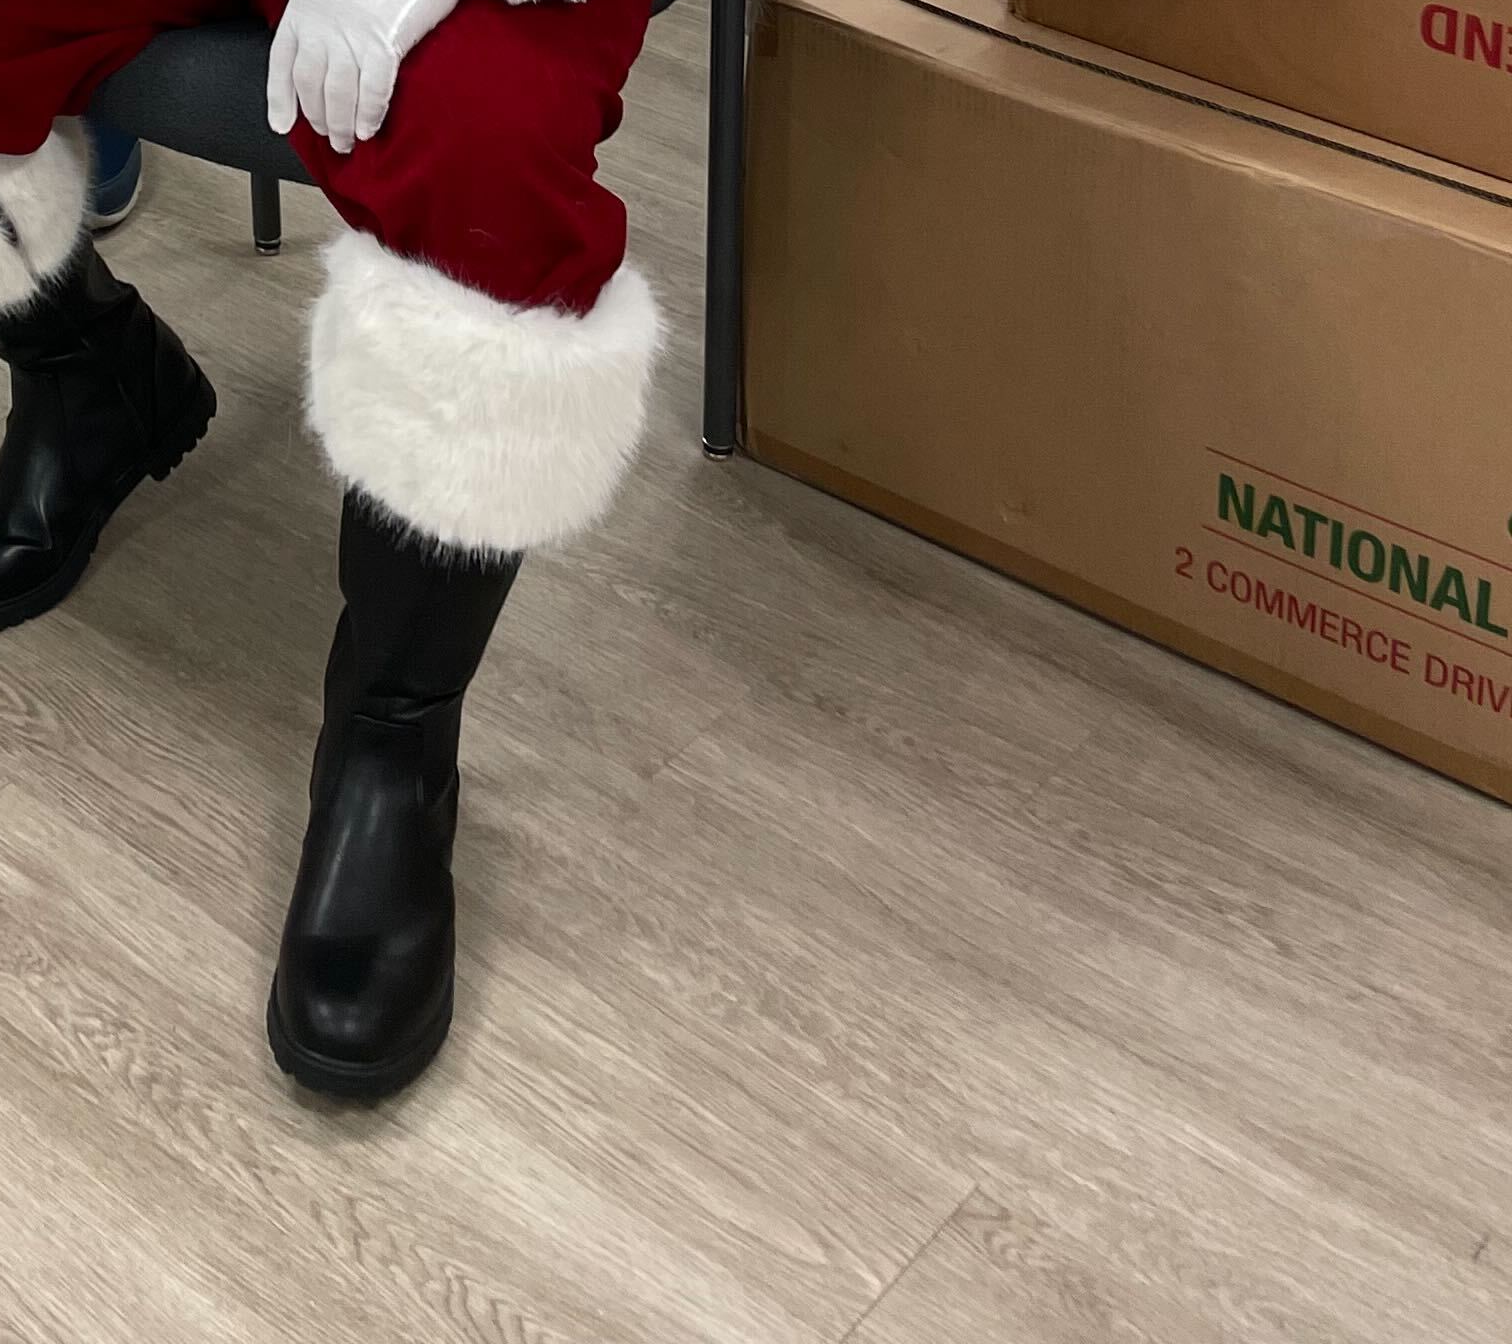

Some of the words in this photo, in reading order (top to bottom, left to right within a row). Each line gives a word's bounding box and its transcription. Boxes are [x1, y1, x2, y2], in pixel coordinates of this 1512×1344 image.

[1420, 3, 1512, 75] ND
[1175, 546, 1194, 579] 2
[1206, 560, 1412, 675] COMMERCE
[1424, 652, 1512, 718] DRIV
[1217, 472, 1509, 639] NATIONAL
